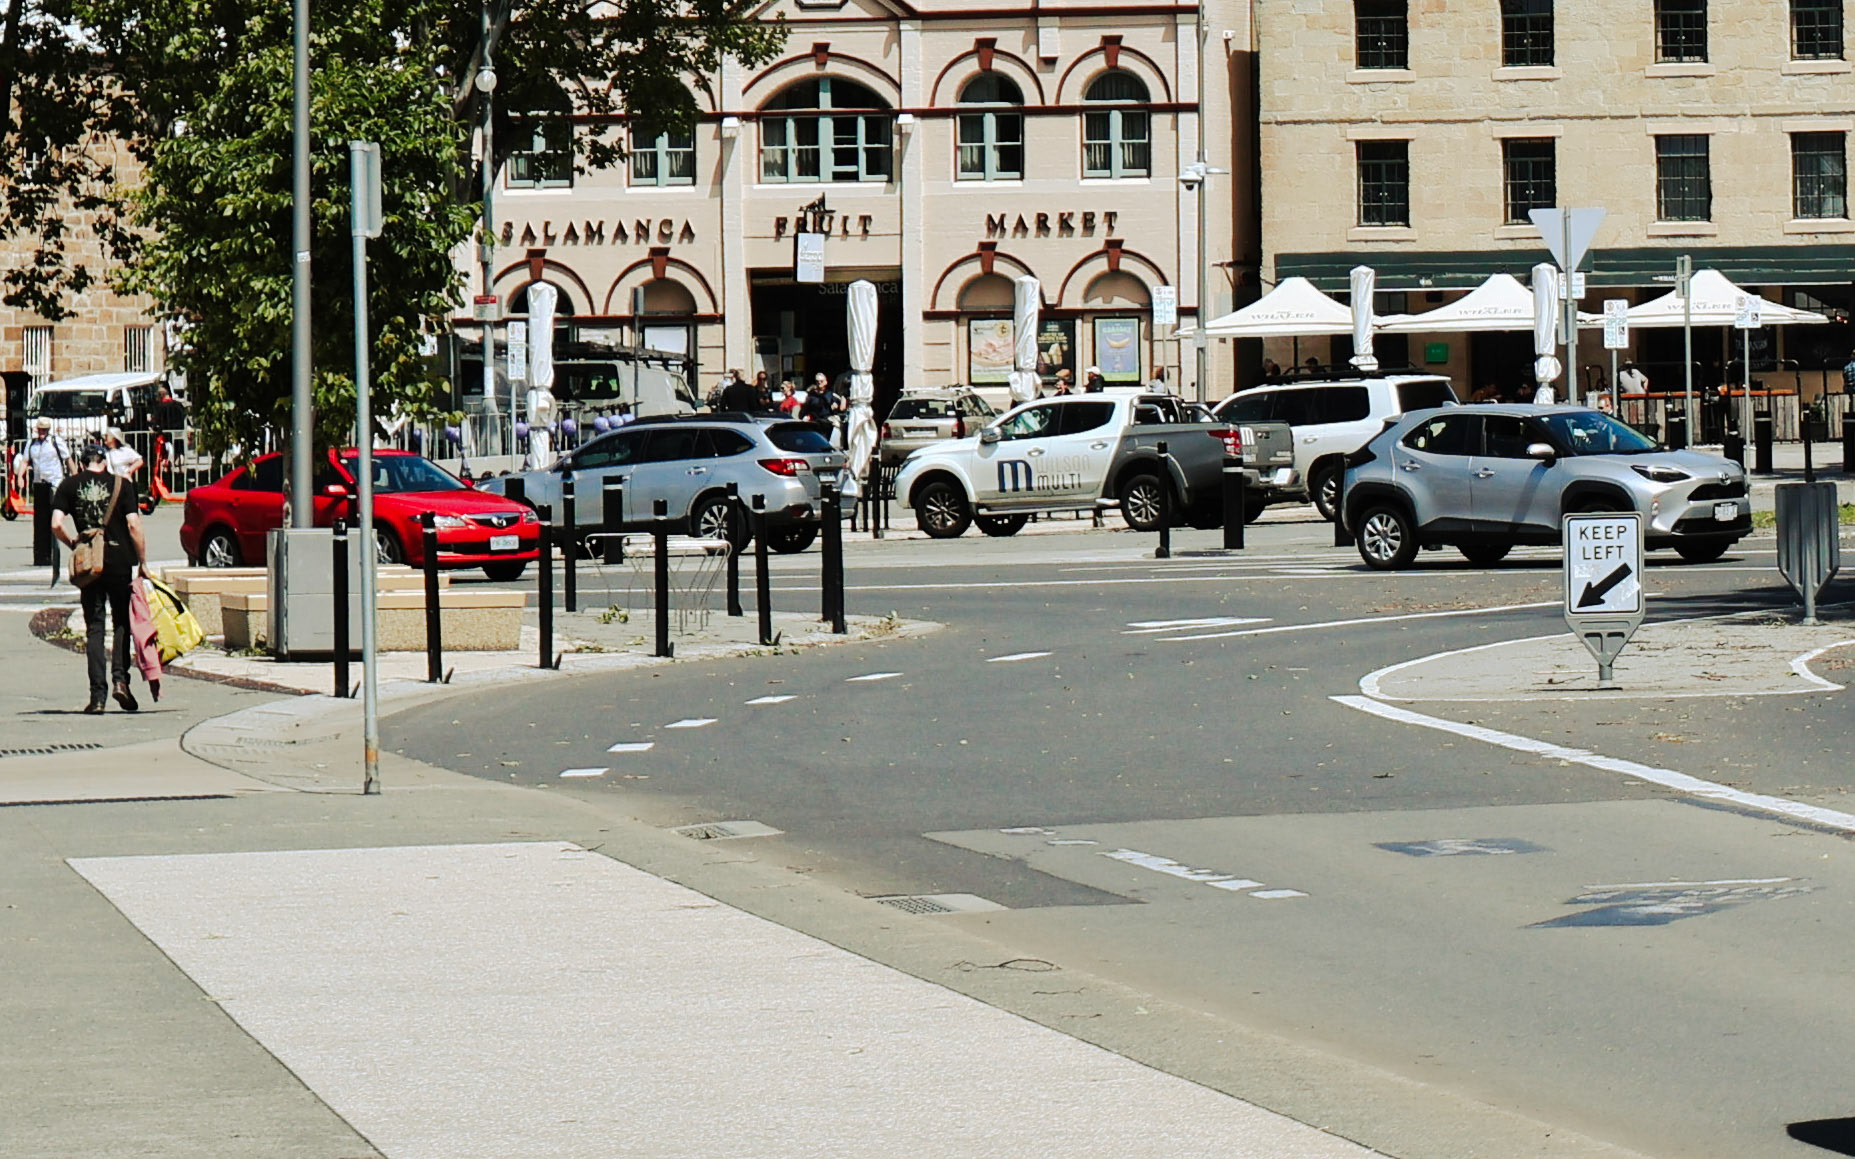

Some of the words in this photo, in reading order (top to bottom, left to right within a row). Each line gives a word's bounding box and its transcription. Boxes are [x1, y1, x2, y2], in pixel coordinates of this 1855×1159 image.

[501, 218, 696, 245] SALAMANCA
[774, 214, 873, 238] FRUIT
[984, 211, 1118, 237] MARKET
[1037, 473, 1082, 490] MULTI
[1579, 525, 1627, 540] KEEP
[1582, 545, 1625, 560] LEFT
